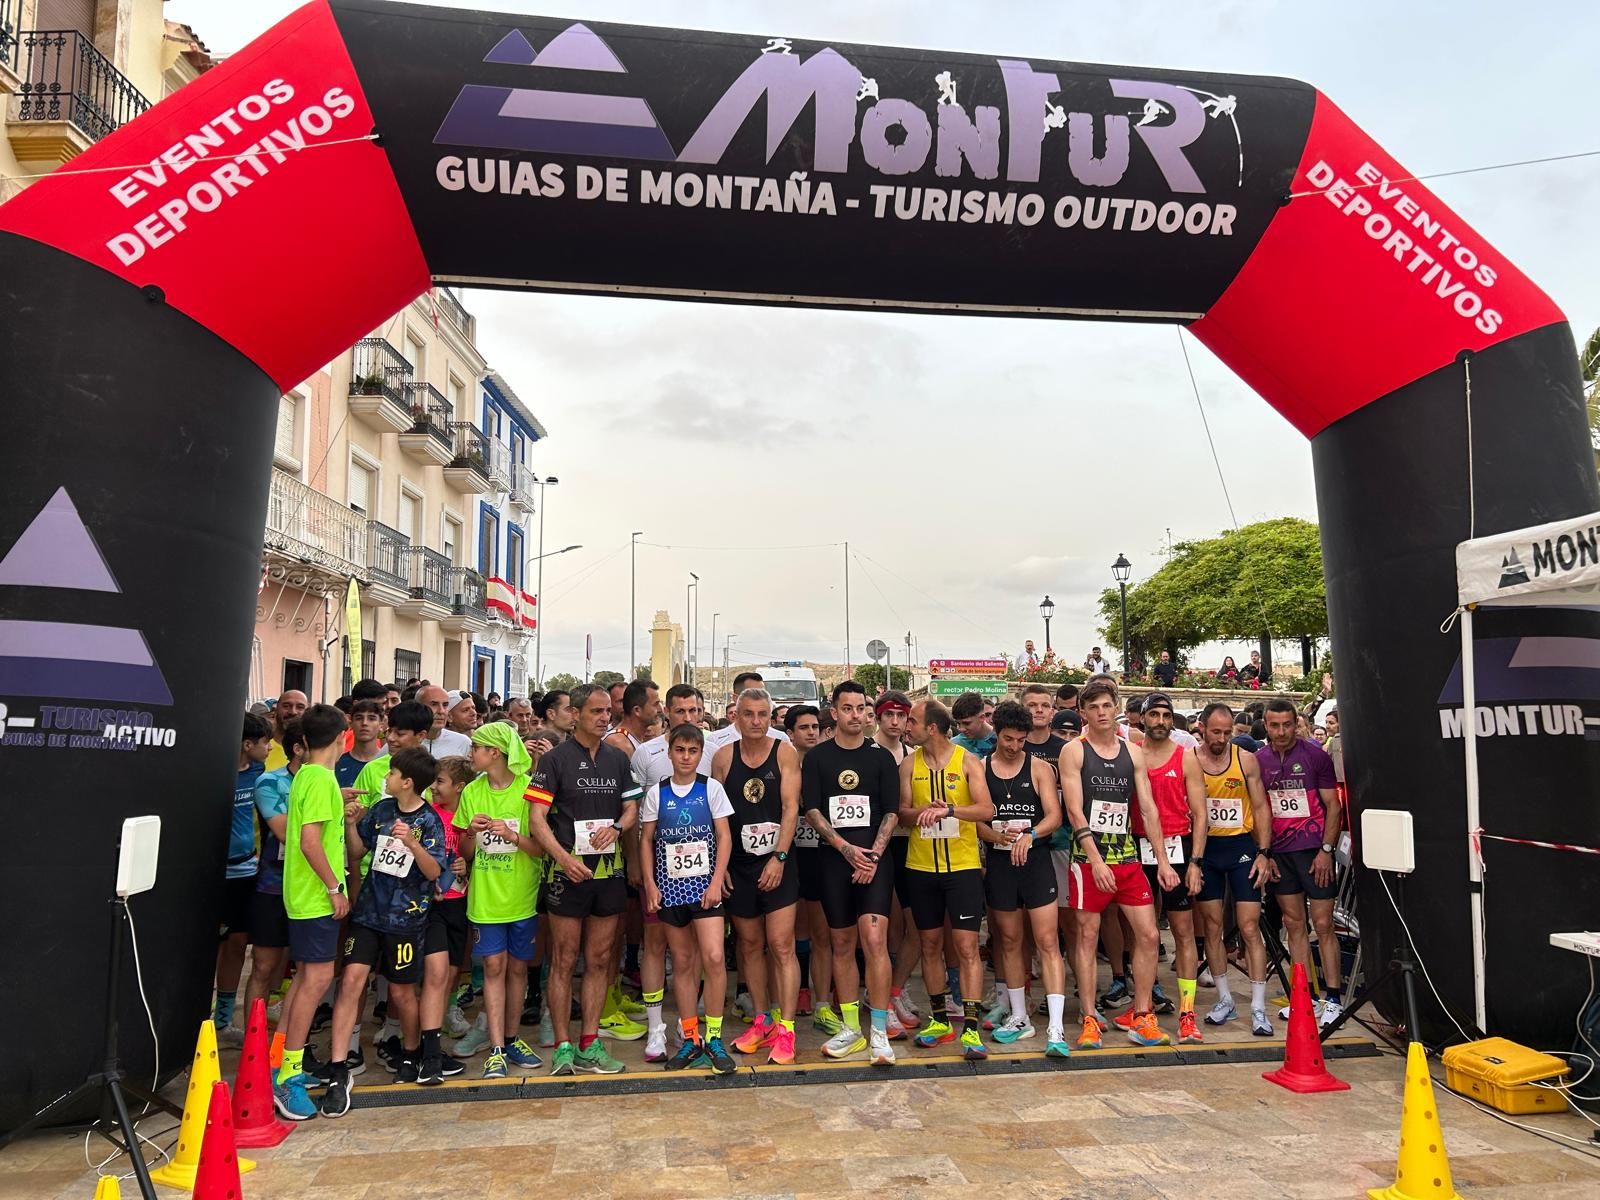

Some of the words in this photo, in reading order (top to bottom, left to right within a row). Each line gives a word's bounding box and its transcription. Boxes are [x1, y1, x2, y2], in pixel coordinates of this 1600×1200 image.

[109, 78, 295, 209] EVENTOS
[106, 86, 356, 268] DEPORTIVOS
[435, 155, 565, 199] GUIAS
[577, 165, 629, 203] DE
[640, 170, 838, 217] MONTAÑA
[870, 185, 1046, 227] TURISMO
[1053, 195, 1237, 236] OUTDOOR
[1355, 161, 1498, 288] EVENTOS
[1305, 160, 1503, 335] DEPORTIVOS
[1531, 527, 1600, 578] MON
[40, 706, 154, 732] TURISMO
[1, 732, 45, 746] GUIAS
[48, 734, 66, 747] DE
[102, 724, 177, 748] ACTIVO
[837, 805, 865, 820] 293
[999, 803, 1036, 812] ARCOS
[1210, 808, 1238, 821] 302
[1280, 799, 1299, 811] 96
[661, 824, 712, 836] POLICLÍNICA
[1097, 812, 1124, 827] 513
[749, 831, 776, 849] 247
[378, 848, 407, 869] 564
[673, 853, 704, 871] 354
[397, 943, 413, 964] 10
